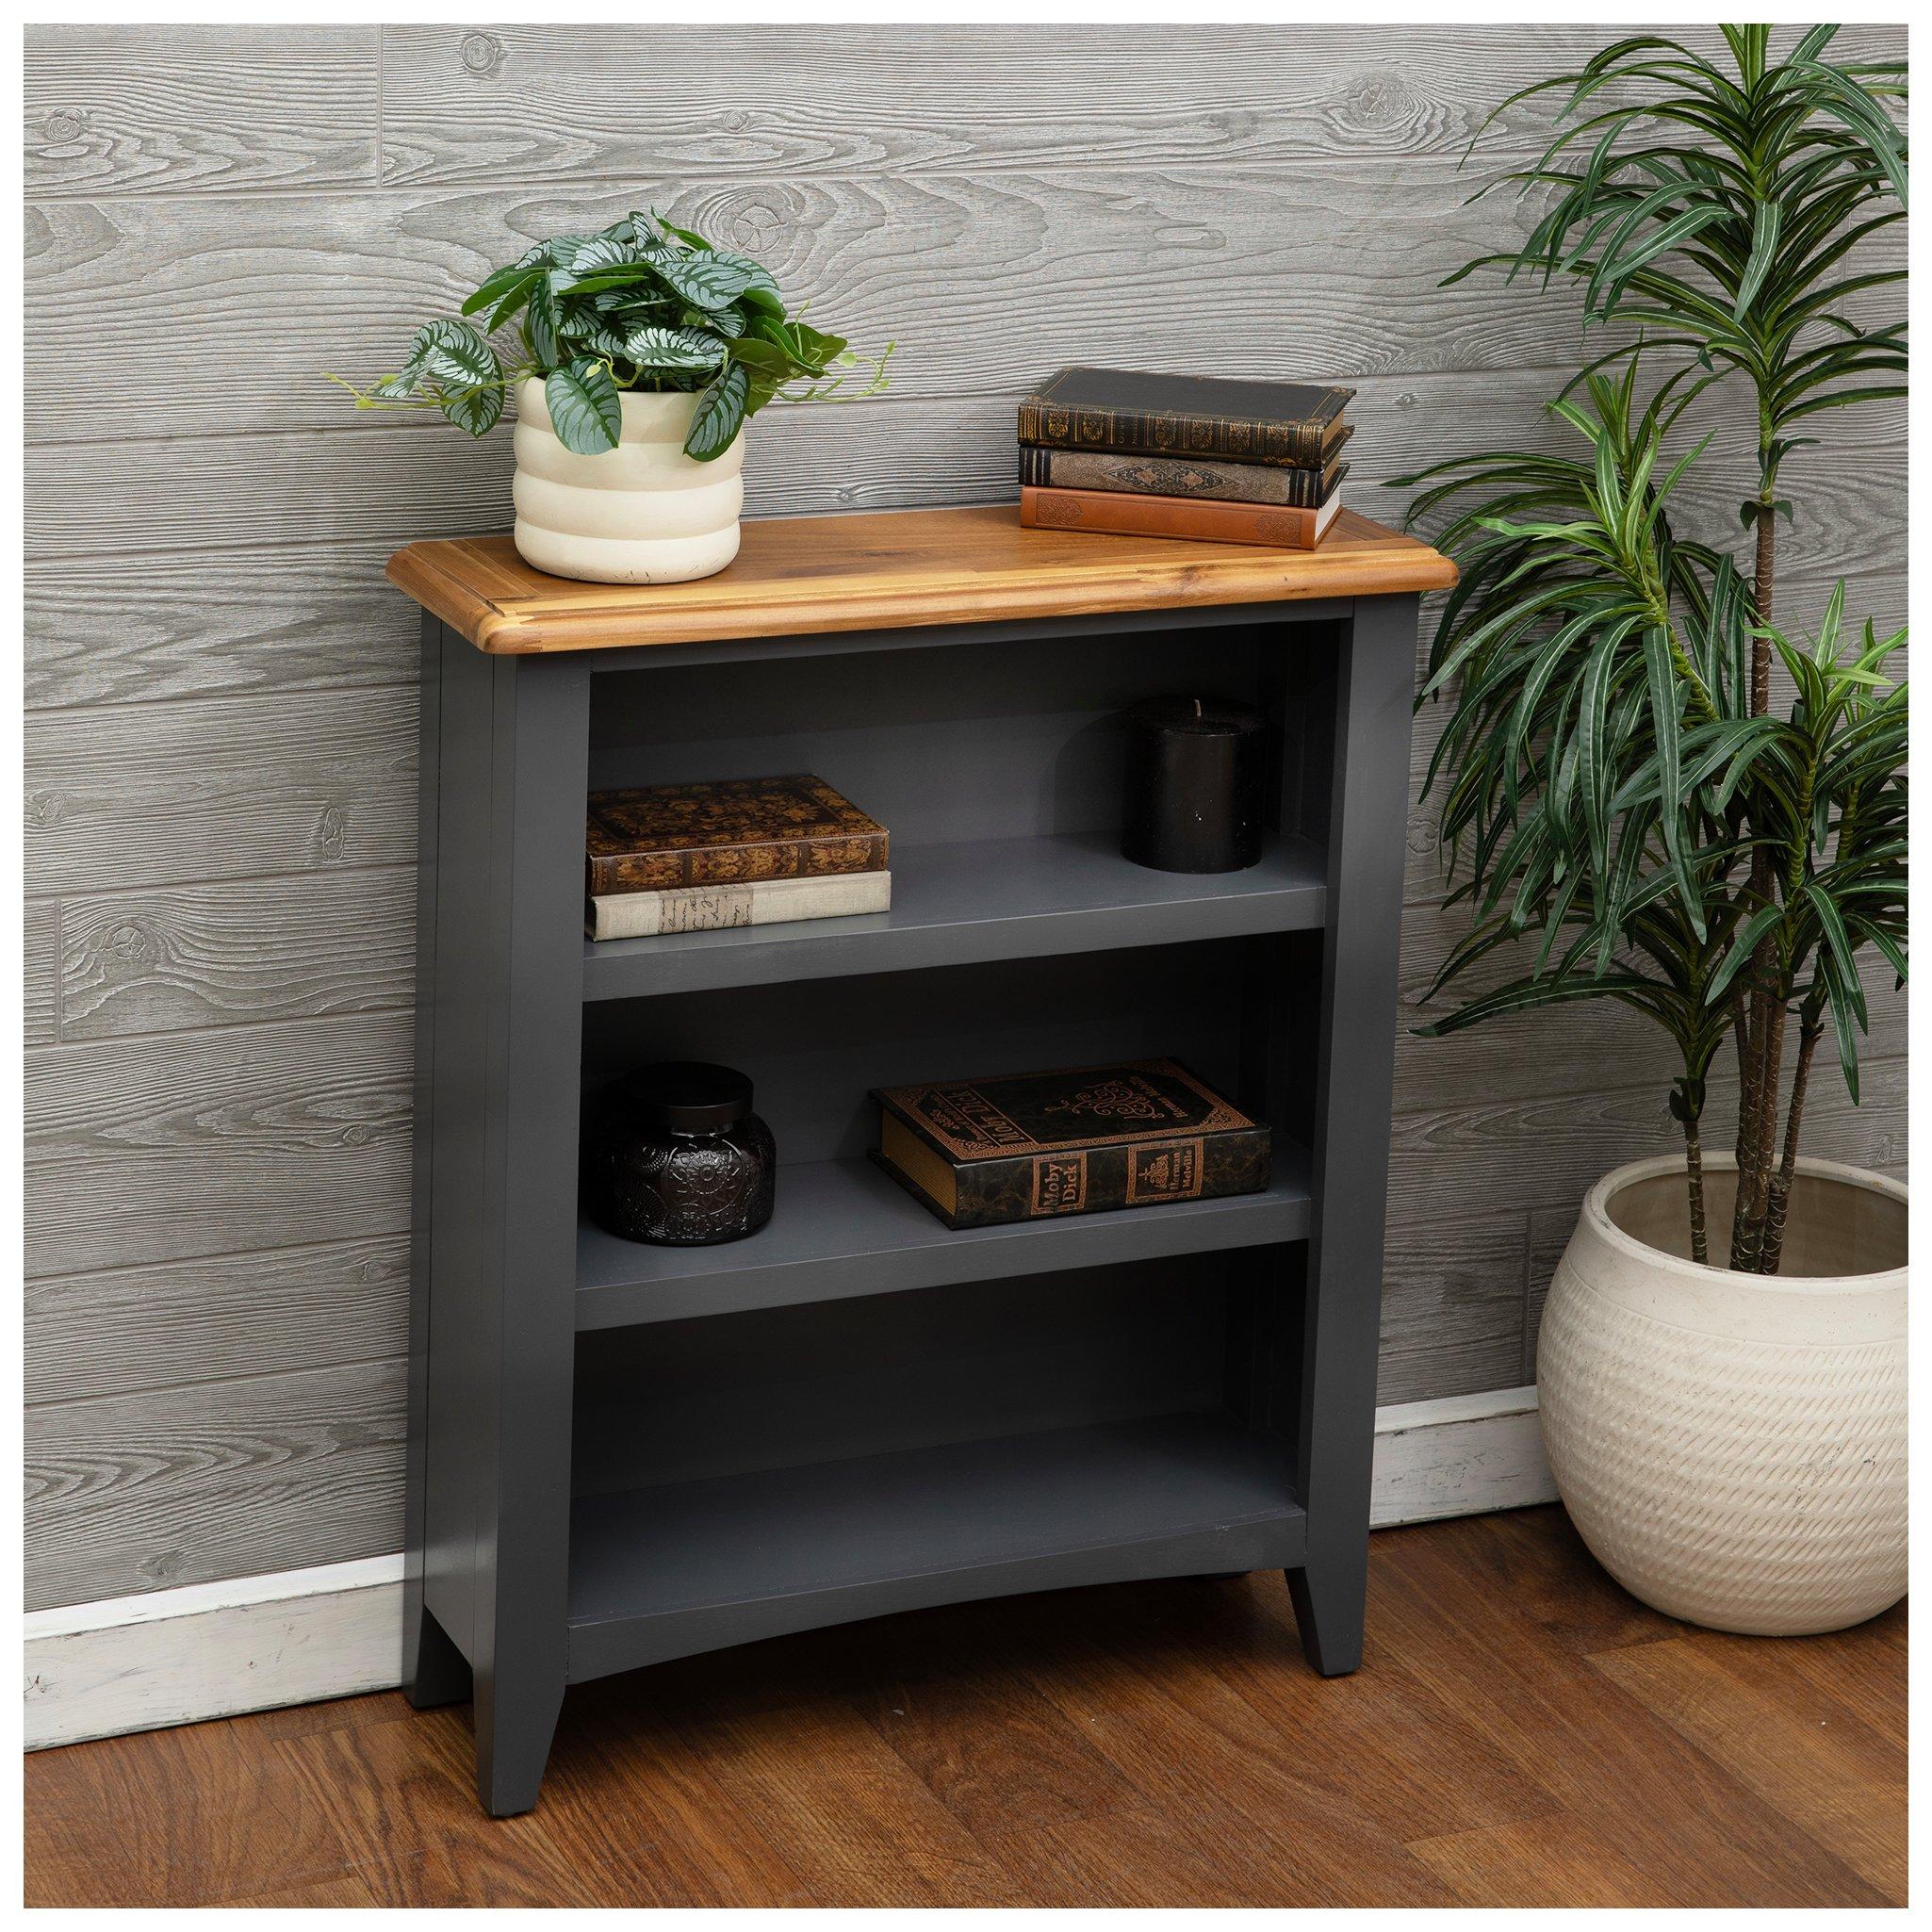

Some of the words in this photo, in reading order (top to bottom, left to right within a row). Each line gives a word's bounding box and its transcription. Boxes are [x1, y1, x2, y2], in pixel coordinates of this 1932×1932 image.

[946, 1090, 991, 1114] Dick
[979, 1116, 1025, 1142] Moby
[1043, 1163, 1063, 1206] Moby
[1062, 1164, 1077, 1203] Dick
[1171, 1152, 1180, 1190] Herman
[1182, 1149, 1192, 1188] Melville
